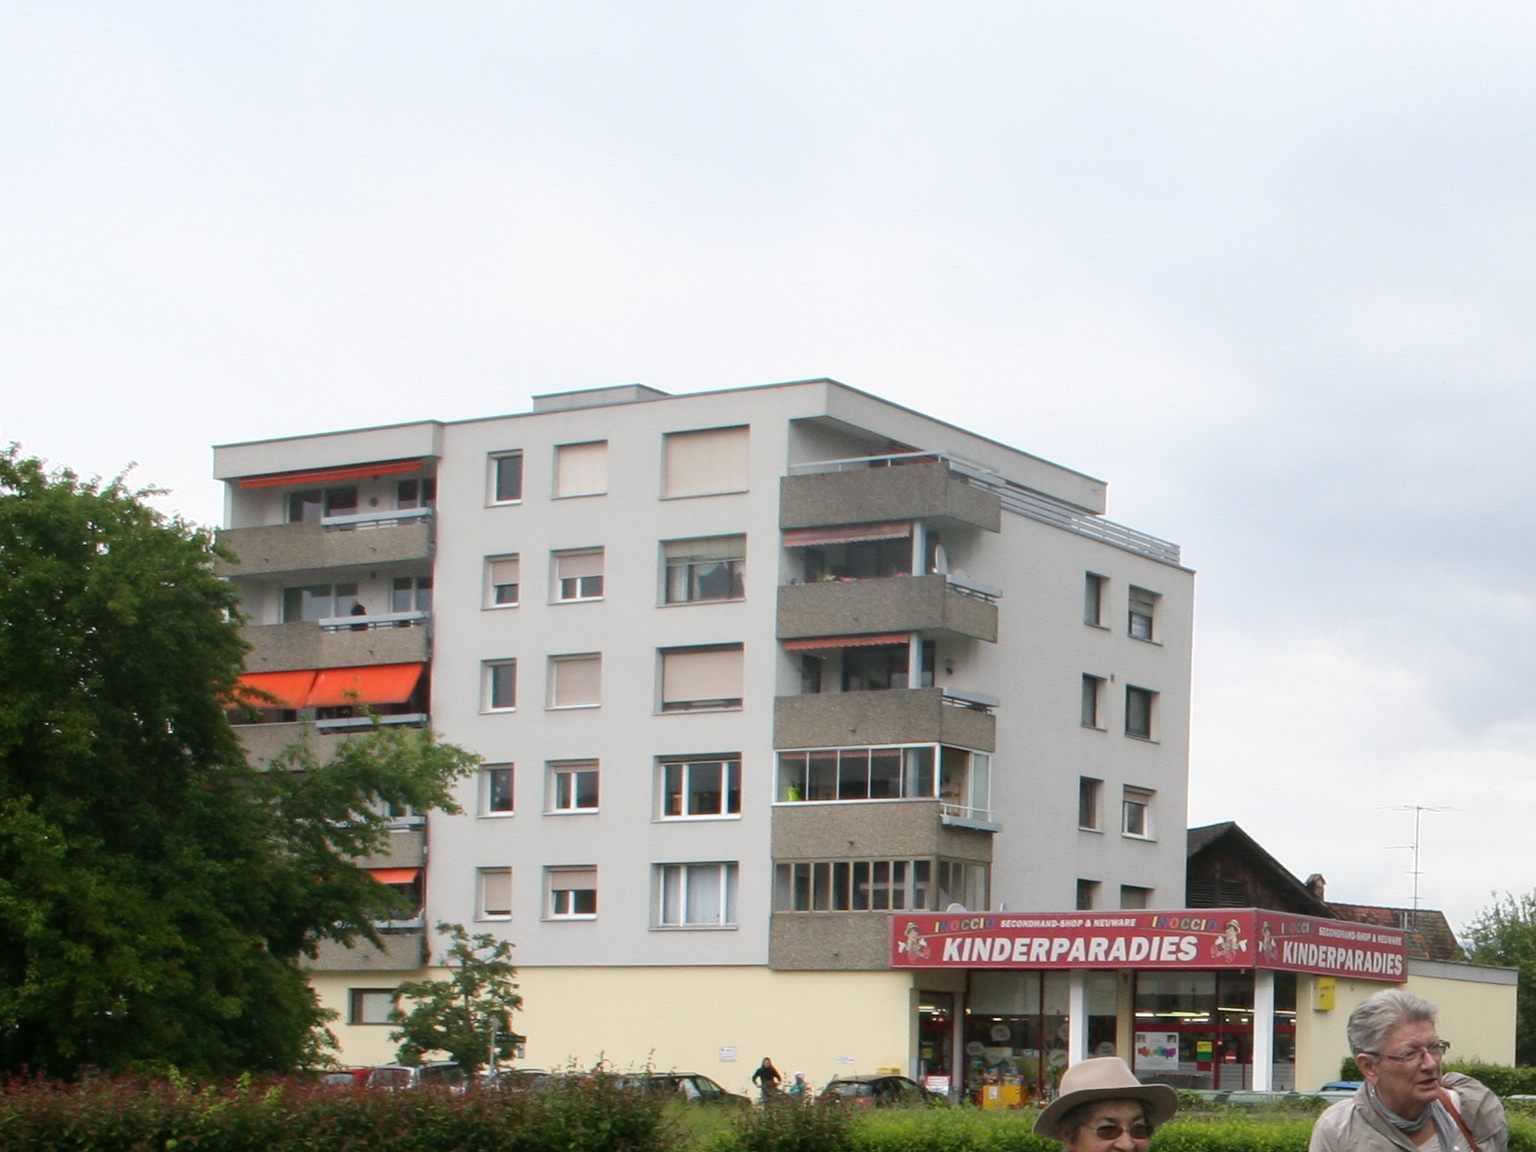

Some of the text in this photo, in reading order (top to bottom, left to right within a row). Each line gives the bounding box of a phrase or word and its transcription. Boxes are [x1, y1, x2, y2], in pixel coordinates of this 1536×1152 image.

[1000, 918, 1137, 928] SECONDHAND-SHOP & NEUWARE
[942, 935, 1199, 962] KINDERPARADIES
[1283, 940, 1403, 975] KINDERPARADIES
